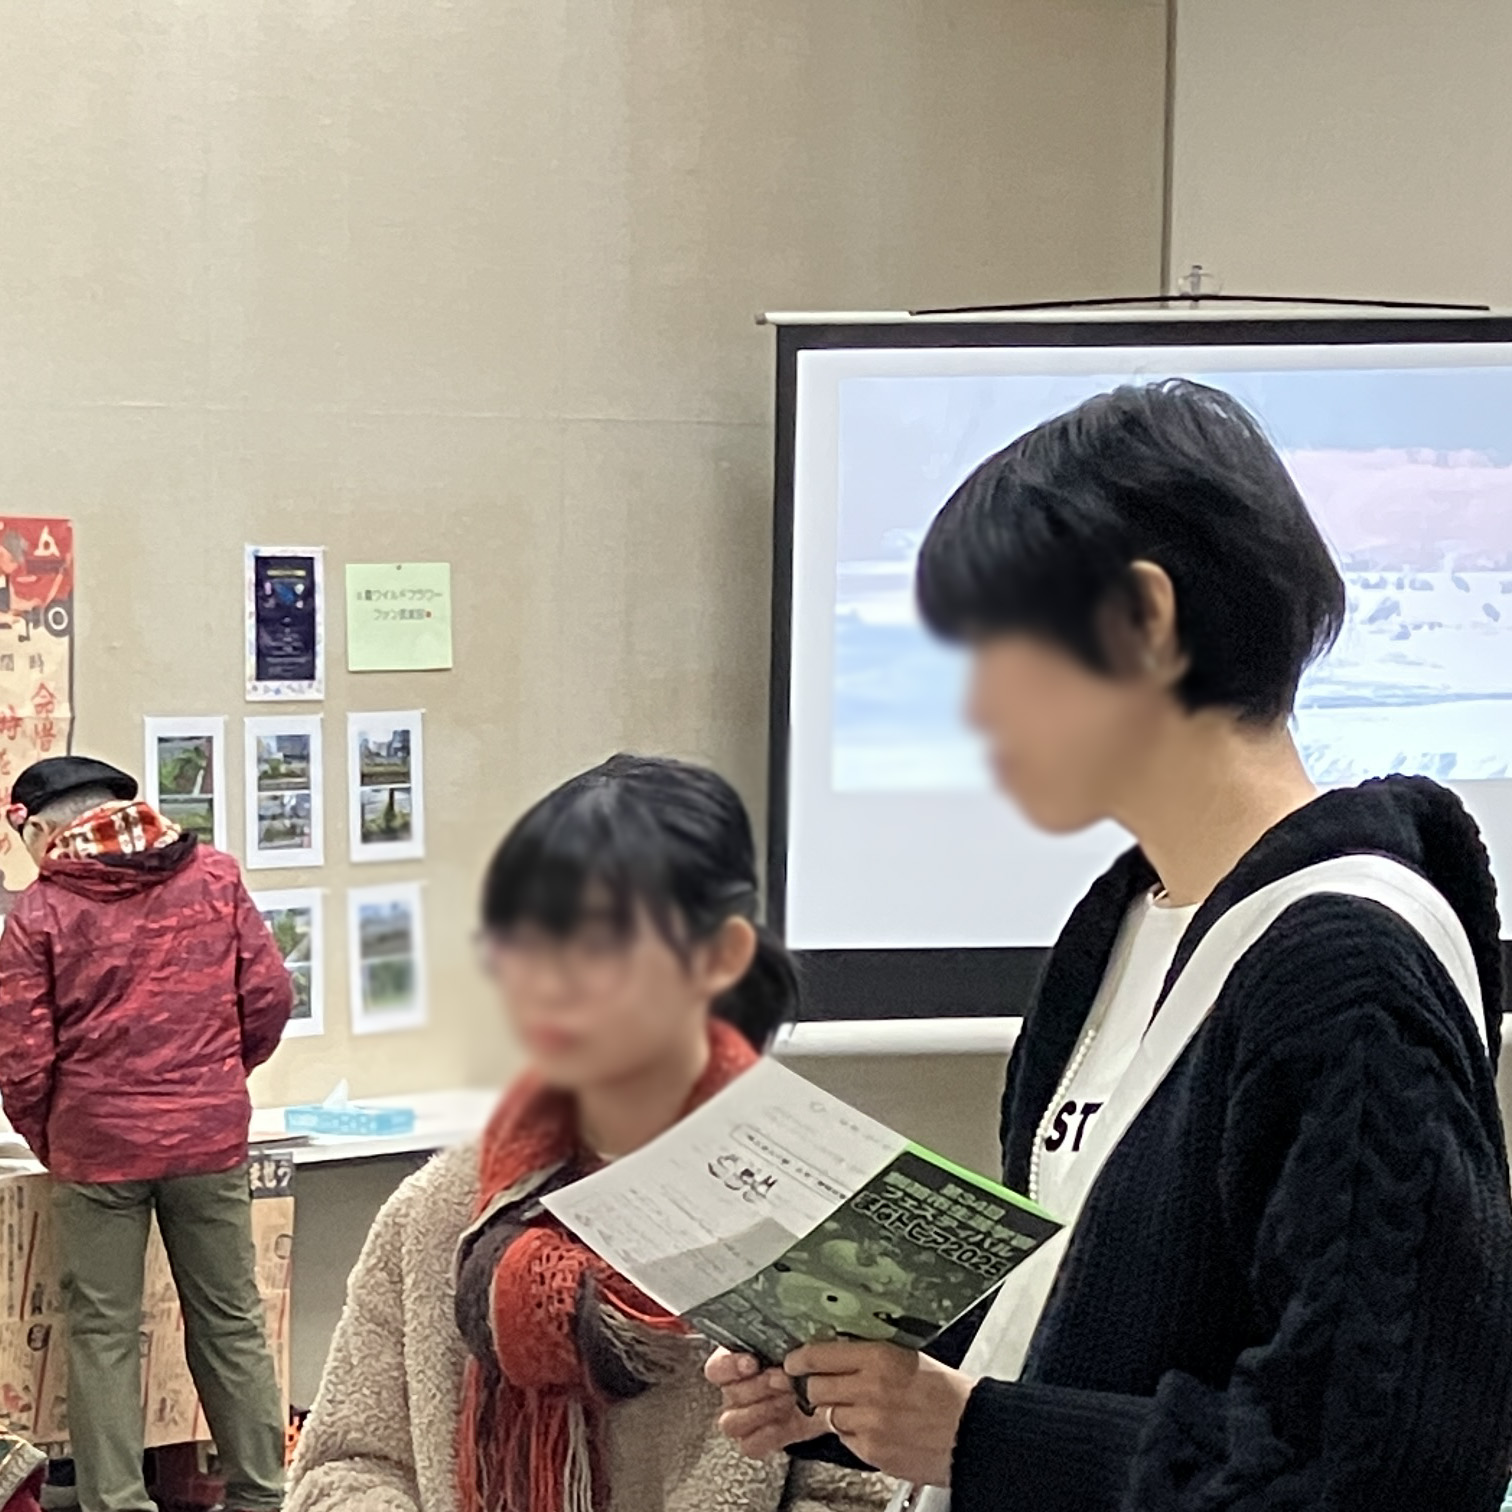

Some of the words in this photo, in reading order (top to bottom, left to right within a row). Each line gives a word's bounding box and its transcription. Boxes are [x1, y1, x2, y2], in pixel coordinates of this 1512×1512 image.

[1045, 1100, 1104, 1152] ST
[882, 1186, 1016, 1257] フェスティバル
